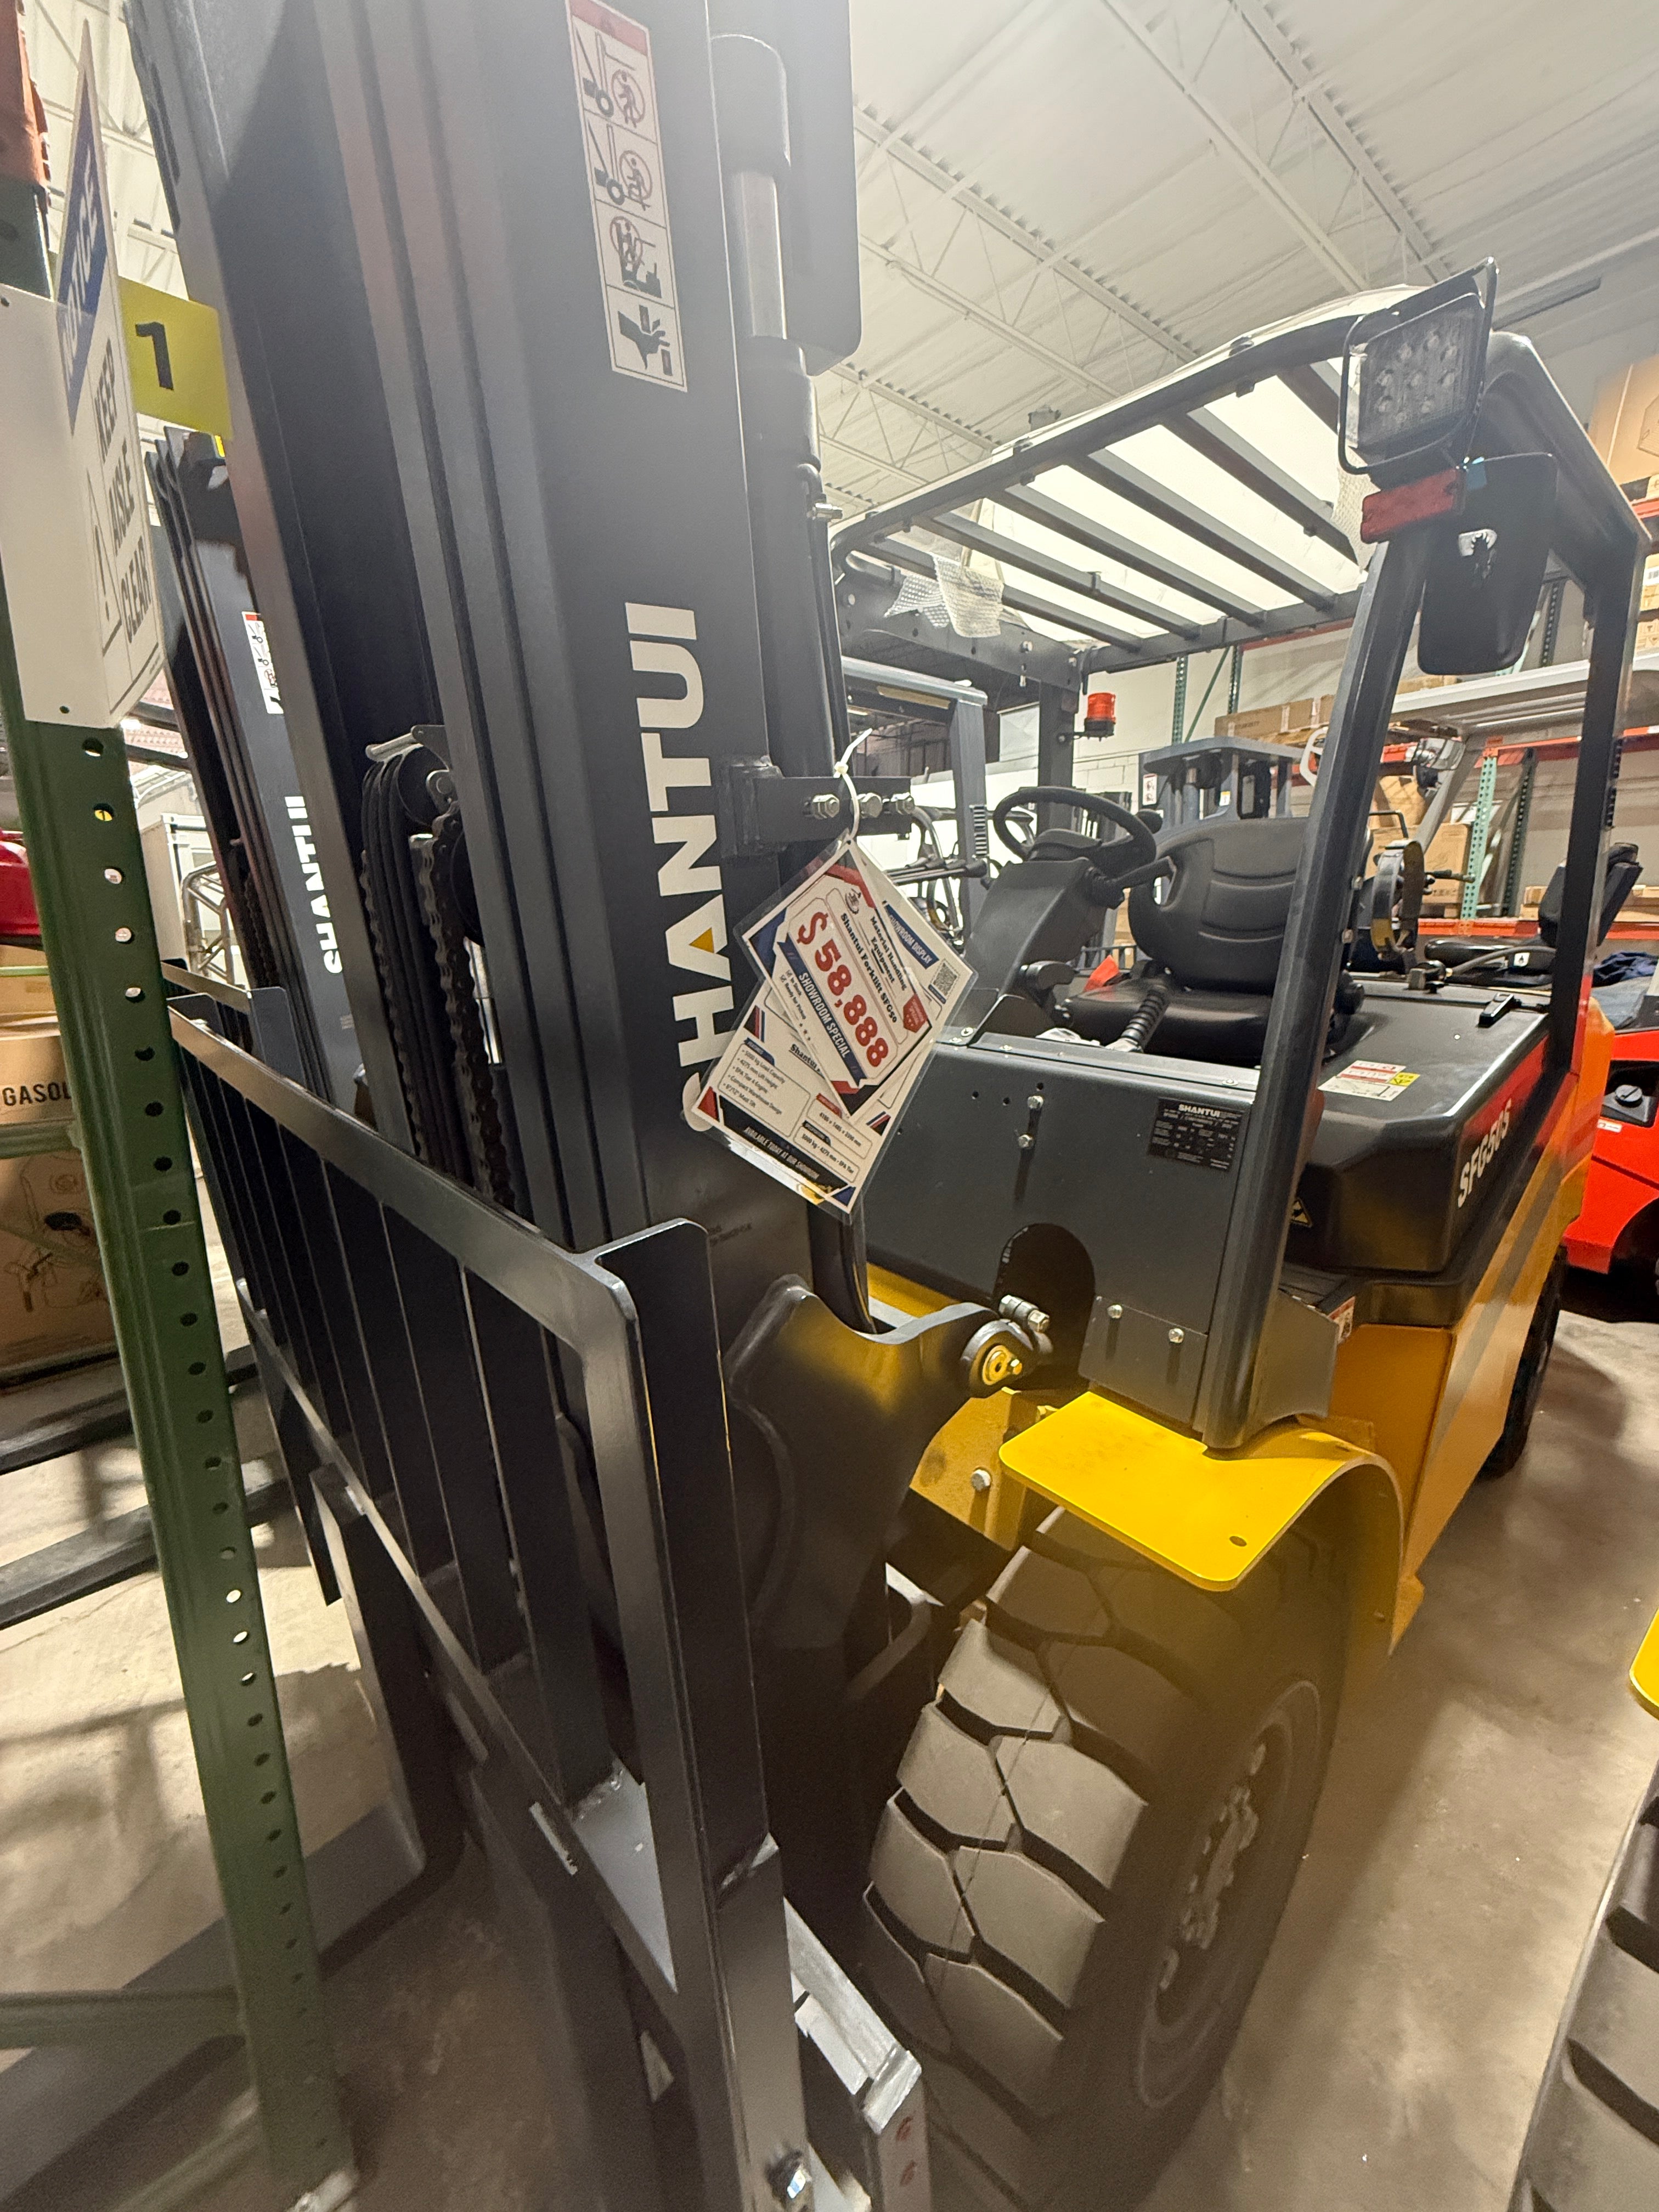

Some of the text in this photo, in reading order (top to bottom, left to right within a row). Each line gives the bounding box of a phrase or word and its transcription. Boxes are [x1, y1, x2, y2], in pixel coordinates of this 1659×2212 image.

[135, 322, 174, 391] 1
[94, 336, 117, 464] KEEP
[109, 437, 135, 557] AISLE
[121, 535, 151, 644] CLEAR
[841, 913, 896, 1022] Shantui Forklift SFG50
[870, 916, 906, 990] Material Handling
[871, 937, 894, 983] Equipment
[912, 943, 932, 963] DISPLAY
[785, 983, 793, 997] Ready
[796, 1004, 806, 1019] Pickup
[799, 973, 849, 1057] SHOWROOM SPECIAL
[791, 1044, 817, 1068] Shantui
[2, 1080, 72, 1106] GASOL
[1178, 1104, 1221, 1118] SHANTUI
